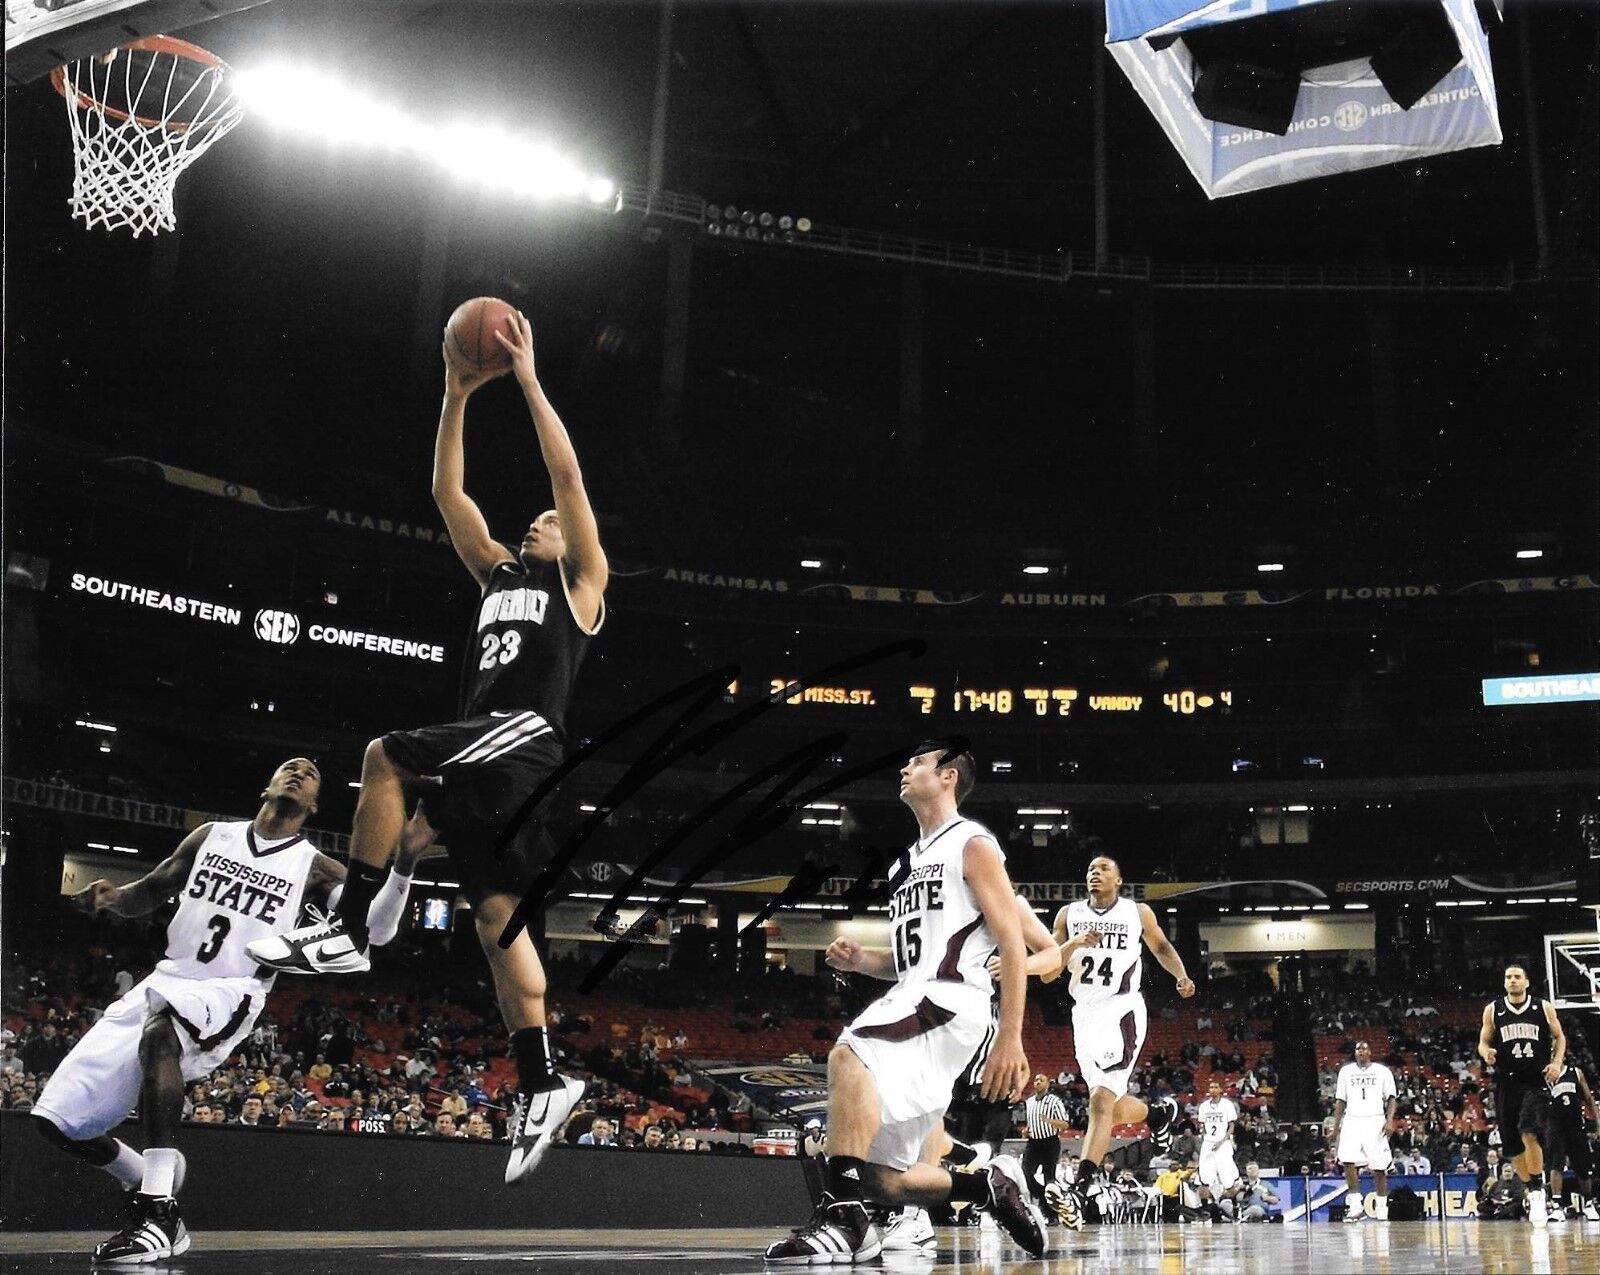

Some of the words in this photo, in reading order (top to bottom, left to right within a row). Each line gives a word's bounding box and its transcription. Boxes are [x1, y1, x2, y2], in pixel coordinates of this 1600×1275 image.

[326, 509, 450, 545] ALABAMA
[665, 568, 788, 593] ARKANSAS
[1000, 592, 1106, 607] AUBURN
[1326, 584, 1440, 600] FLORIDA
[71, 573, 241, 625] SOUTHEASTERN
[256, 609, 299, 644] SEC
[308, 625, 444, 662] CONFERENCE
[479, 630, 521, 670] 23
[921, 698, 933, 714] 2
[953, 690, 1012, 713] 17:48
[1089, 696, 1143, 711] VANDY
[1163, 690, 1196, 714] 40
[1220, 691, 1232, 706] 4
[202, 852, 293, 896] MISSISSIPPI
[1336, 879, 1449, 893] SECSPORTS.COM
[189, 869, 286, 925] STATE
[1073, 921, 1128, 934] MISSISSIPPI
[1276, 932, 1306, 941] MEN
[196, 914, 231, 964] 3
[896, 917, 922, 972] 15
[1081, 956, 1113, 986] 24
[1511, 1042, 1534, 1059] 44
[1350, 1077, 1377, 1087] STATE
[1361, 1087, 1366, 1100] 1
[1562, 1095, 1571, 1106] 3
[1211, 1125, 1217, 1136] 2
